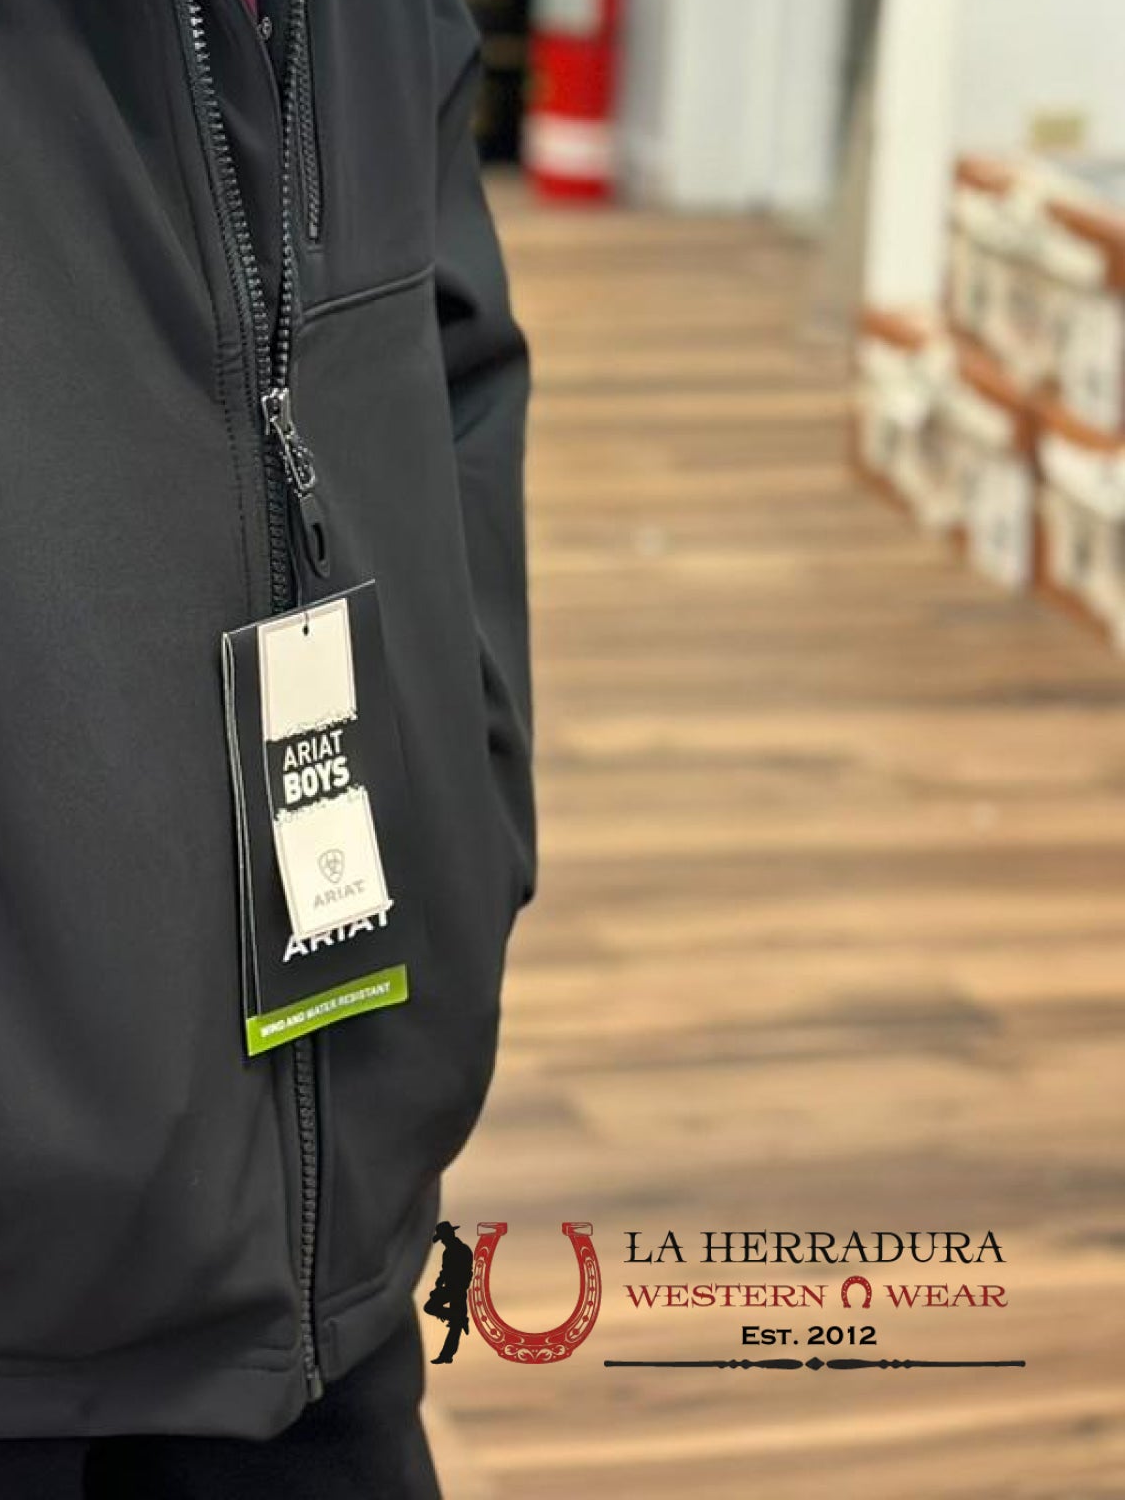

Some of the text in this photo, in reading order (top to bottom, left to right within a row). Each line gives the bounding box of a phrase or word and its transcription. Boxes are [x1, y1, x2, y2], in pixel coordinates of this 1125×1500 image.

[283, 729, 343, 771] ARIAT
[283, 755, 350, 805] BOYS
[314, 879, 365, 908] ARIAT
